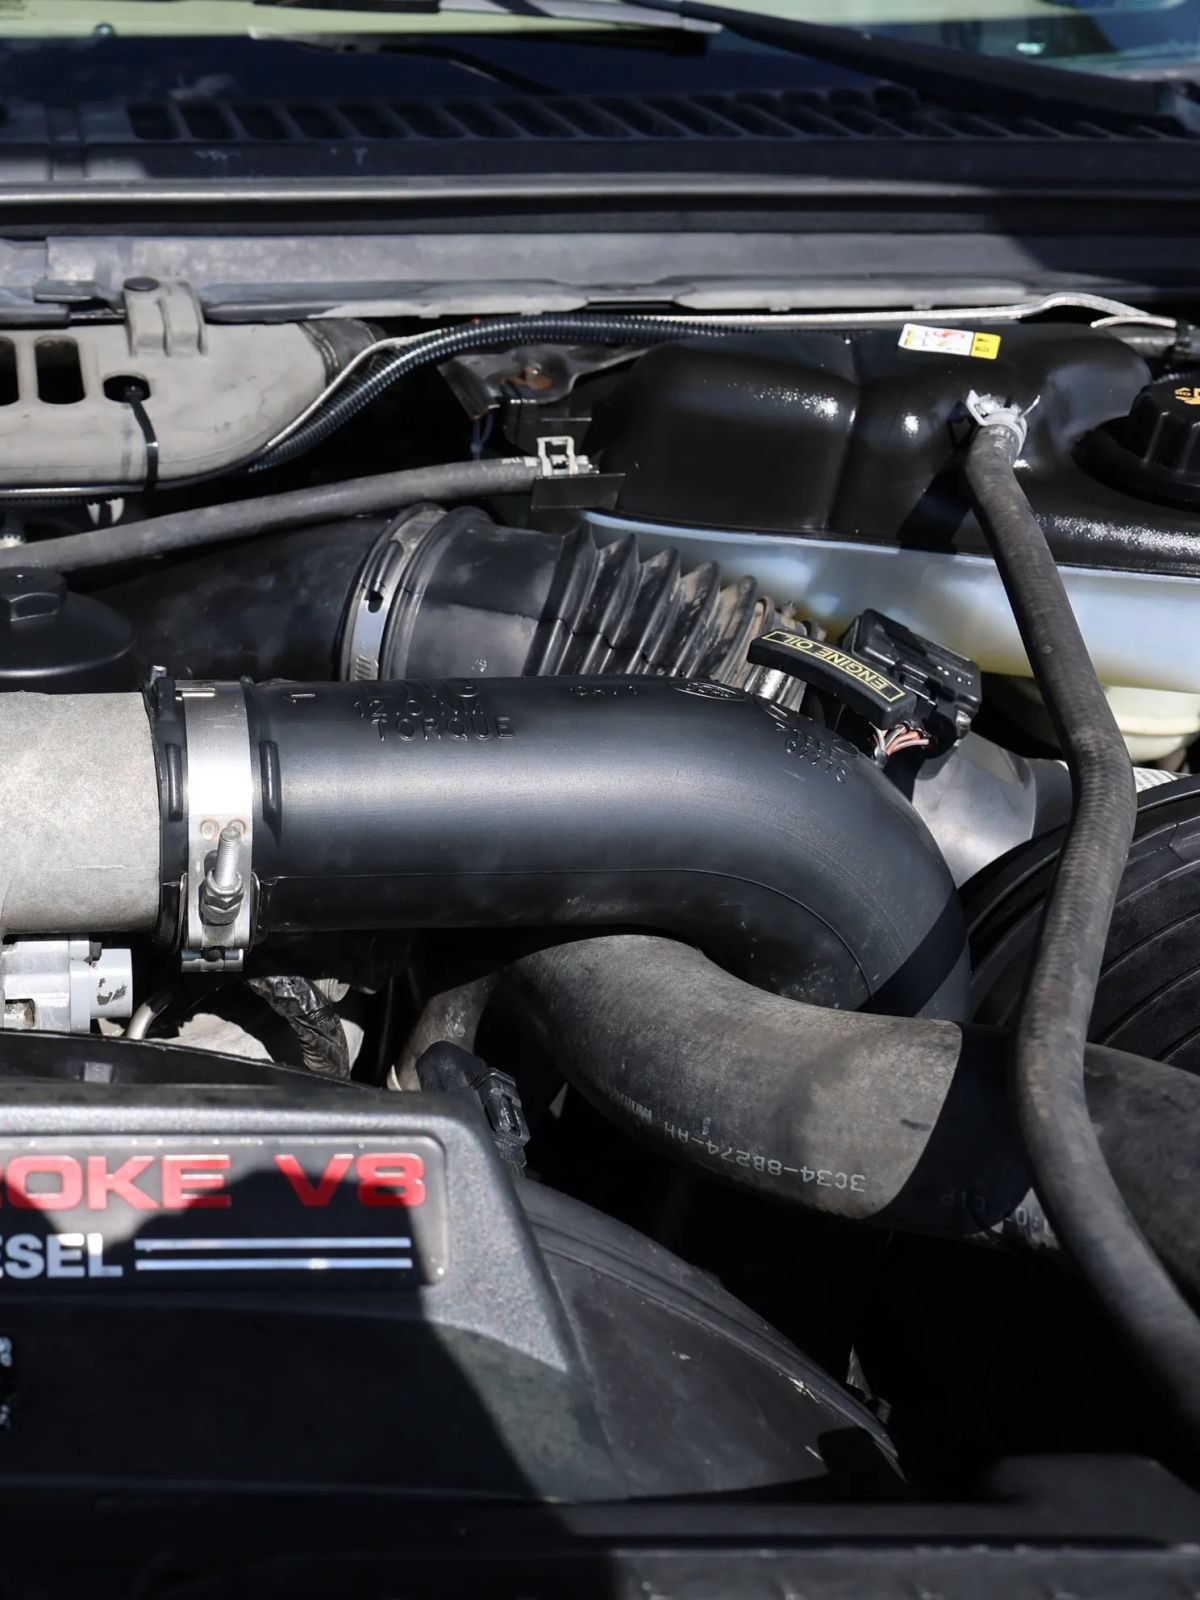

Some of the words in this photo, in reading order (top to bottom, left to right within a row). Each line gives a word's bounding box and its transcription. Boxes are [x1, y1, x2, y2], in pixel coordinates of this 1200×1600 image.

[783, 634, 814, 650] OIL
[814, 646, 888, 691] ENGINE
[370, 717, 516, 743] TORQUE
[273, 1152, 427, 1208] V8
